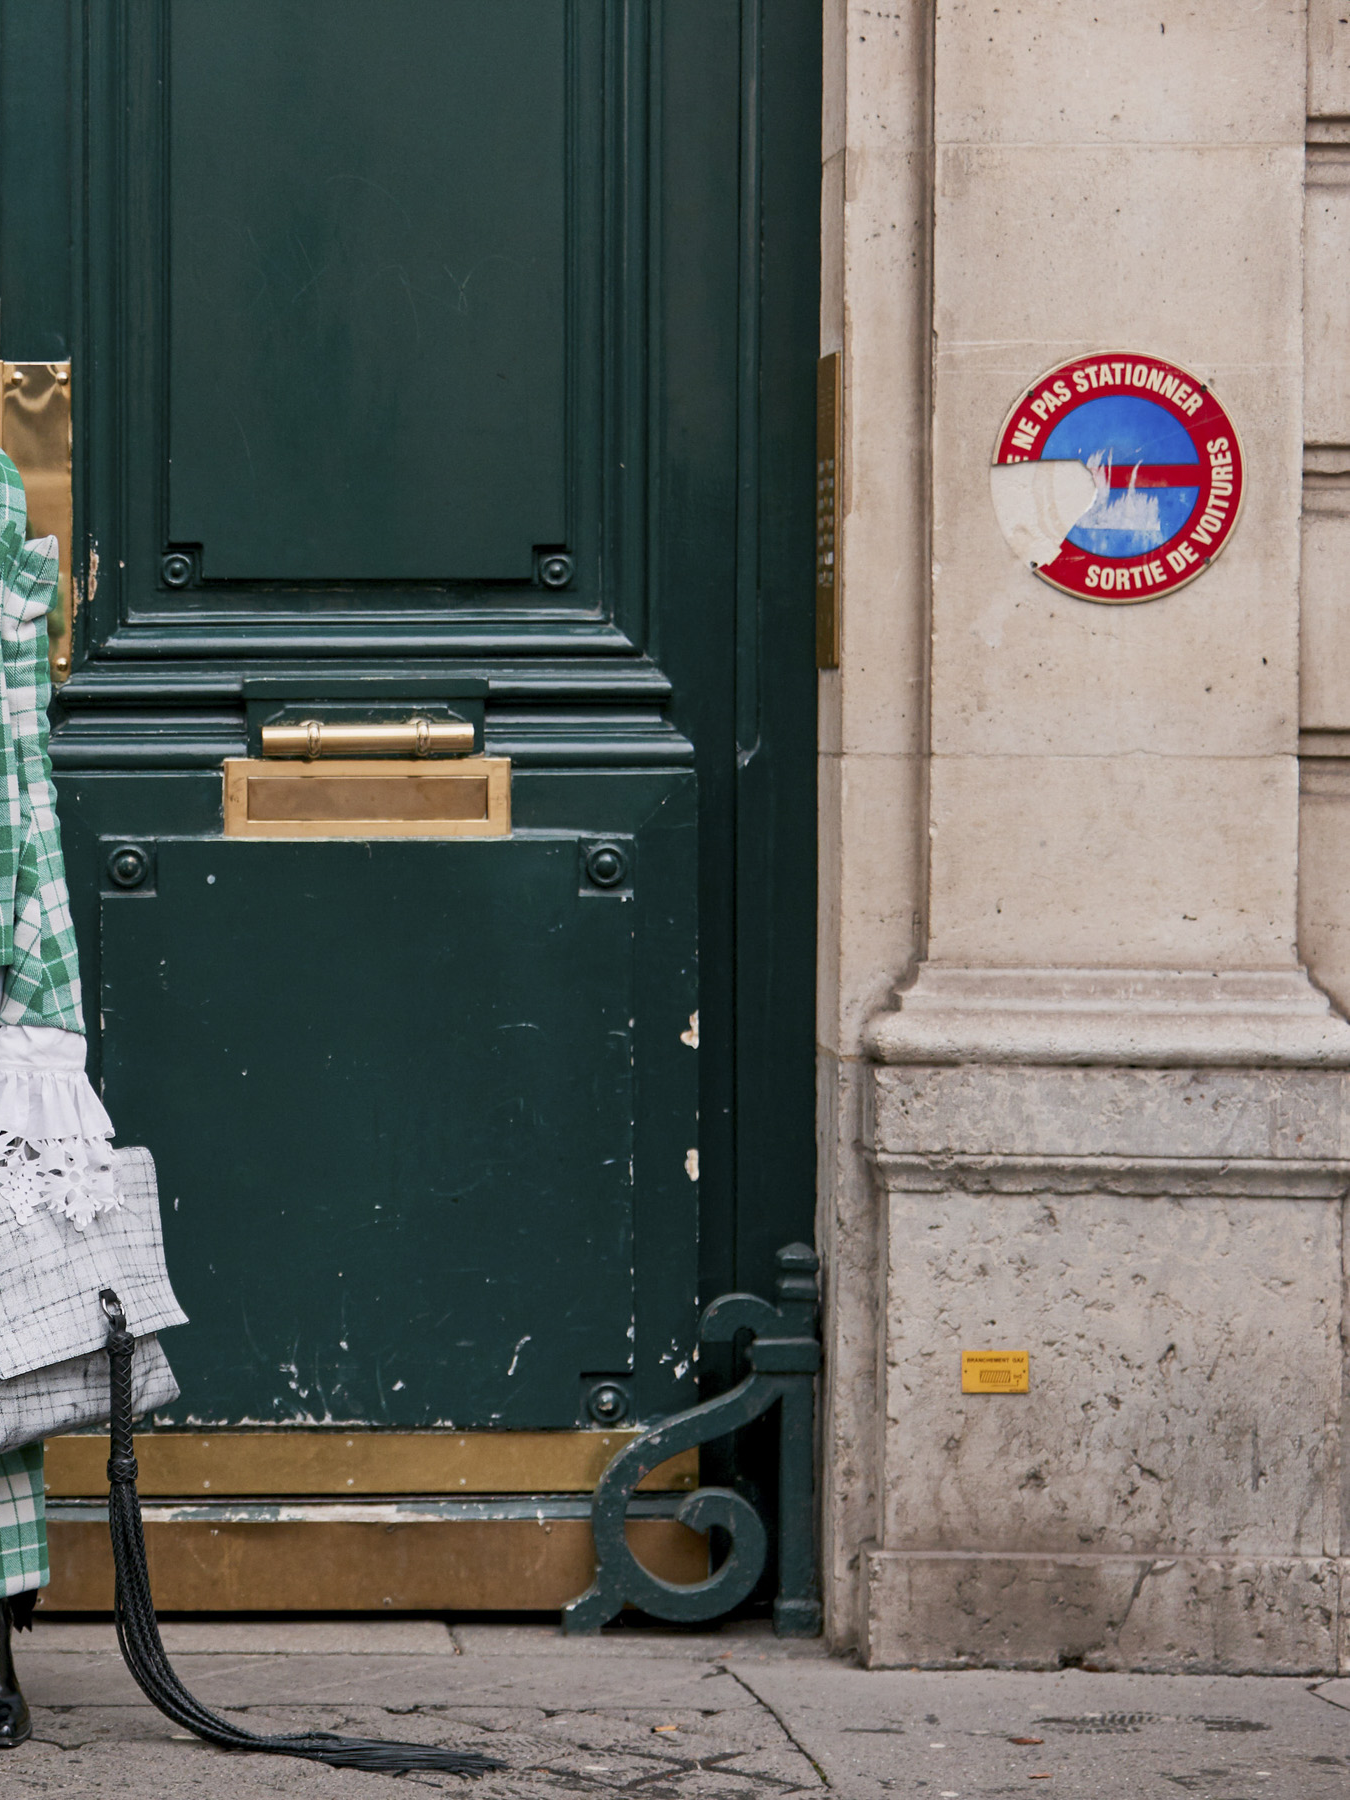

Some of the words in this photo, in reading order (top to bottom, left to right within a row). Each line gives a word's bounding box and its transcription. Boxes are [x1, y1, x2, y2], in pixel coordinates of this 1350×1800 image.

[1011, 416, 1041, 451] NE
[1031, 381, 1071, 421] PAS
[1072, 363, 1203, 417] STATIONNER
[1085, 560, 1167, 590] SORTIE
[1166, 541, 1199, 573] DE
[1190, 437, 1233, 545] VOITURES
